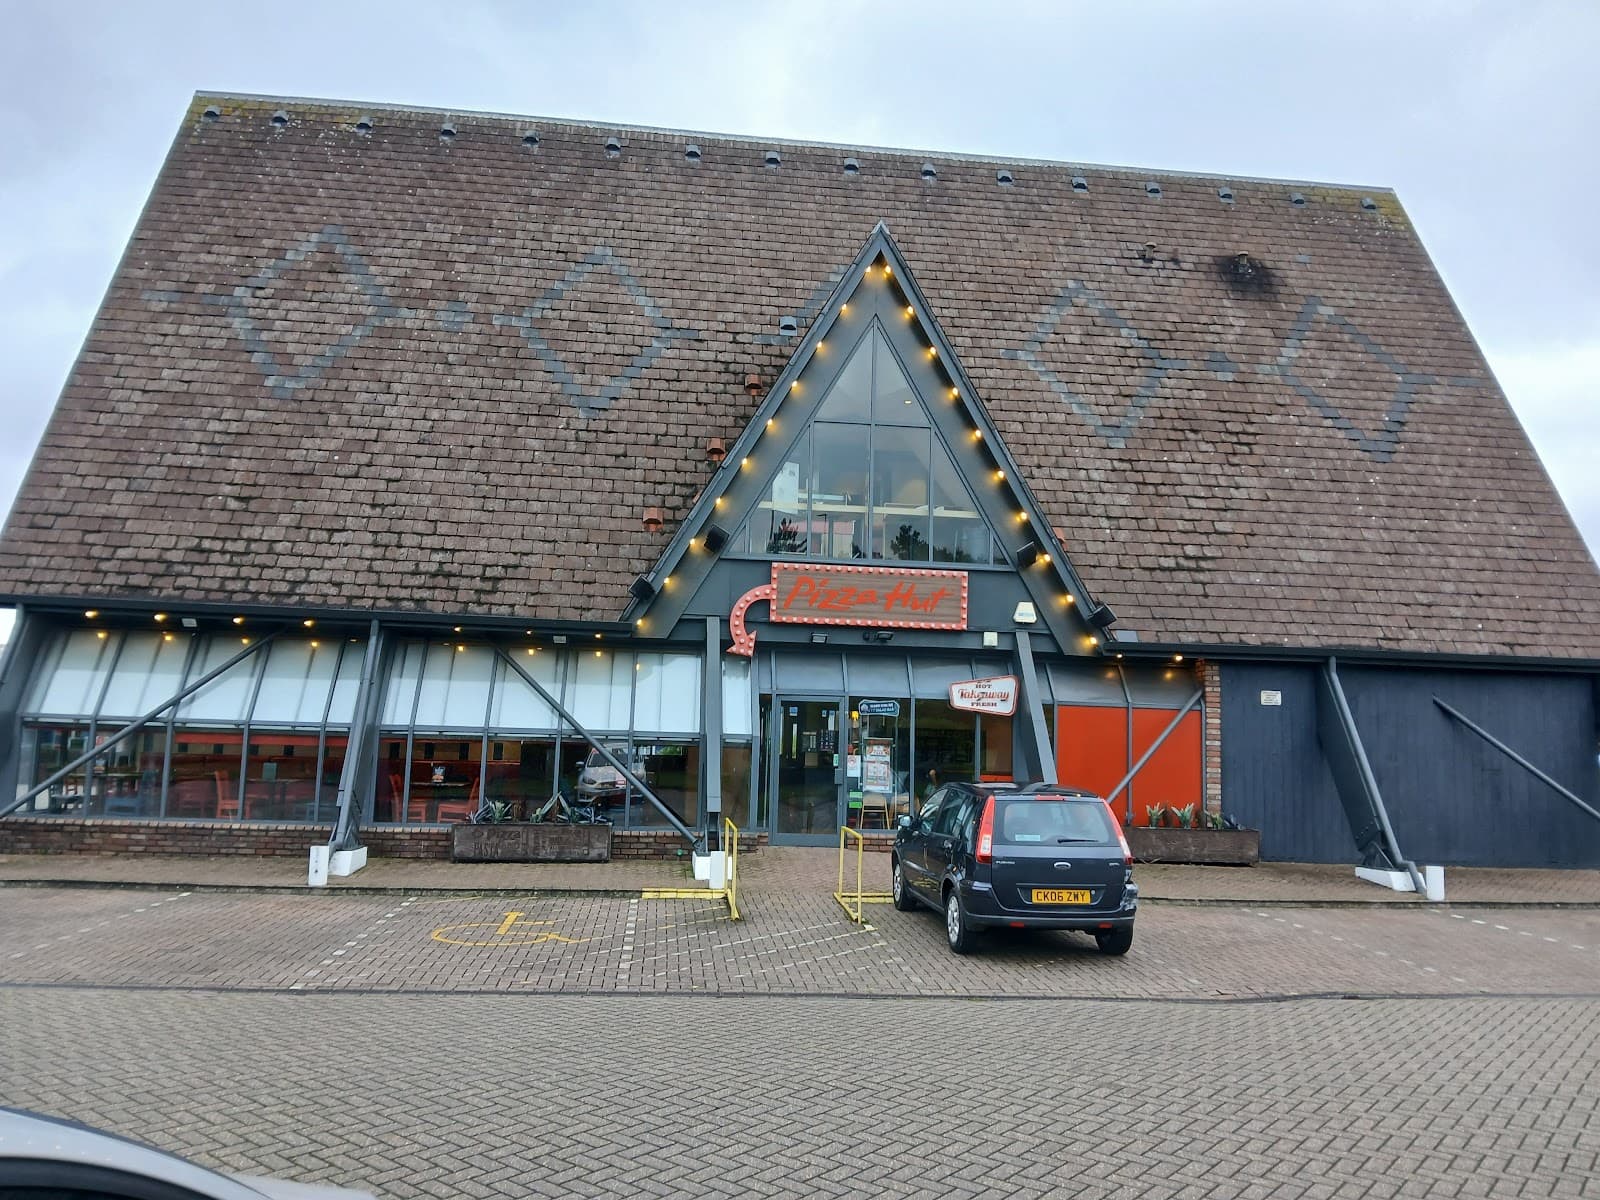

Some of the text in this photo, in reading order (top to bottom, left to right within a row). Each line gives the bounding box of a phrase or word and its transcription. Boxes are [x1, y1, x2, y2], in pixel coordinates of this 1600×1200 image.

[783, 576, 950, 613] Pizza Hut
[1036, 891, 1086, 902] CK06 ZWY
